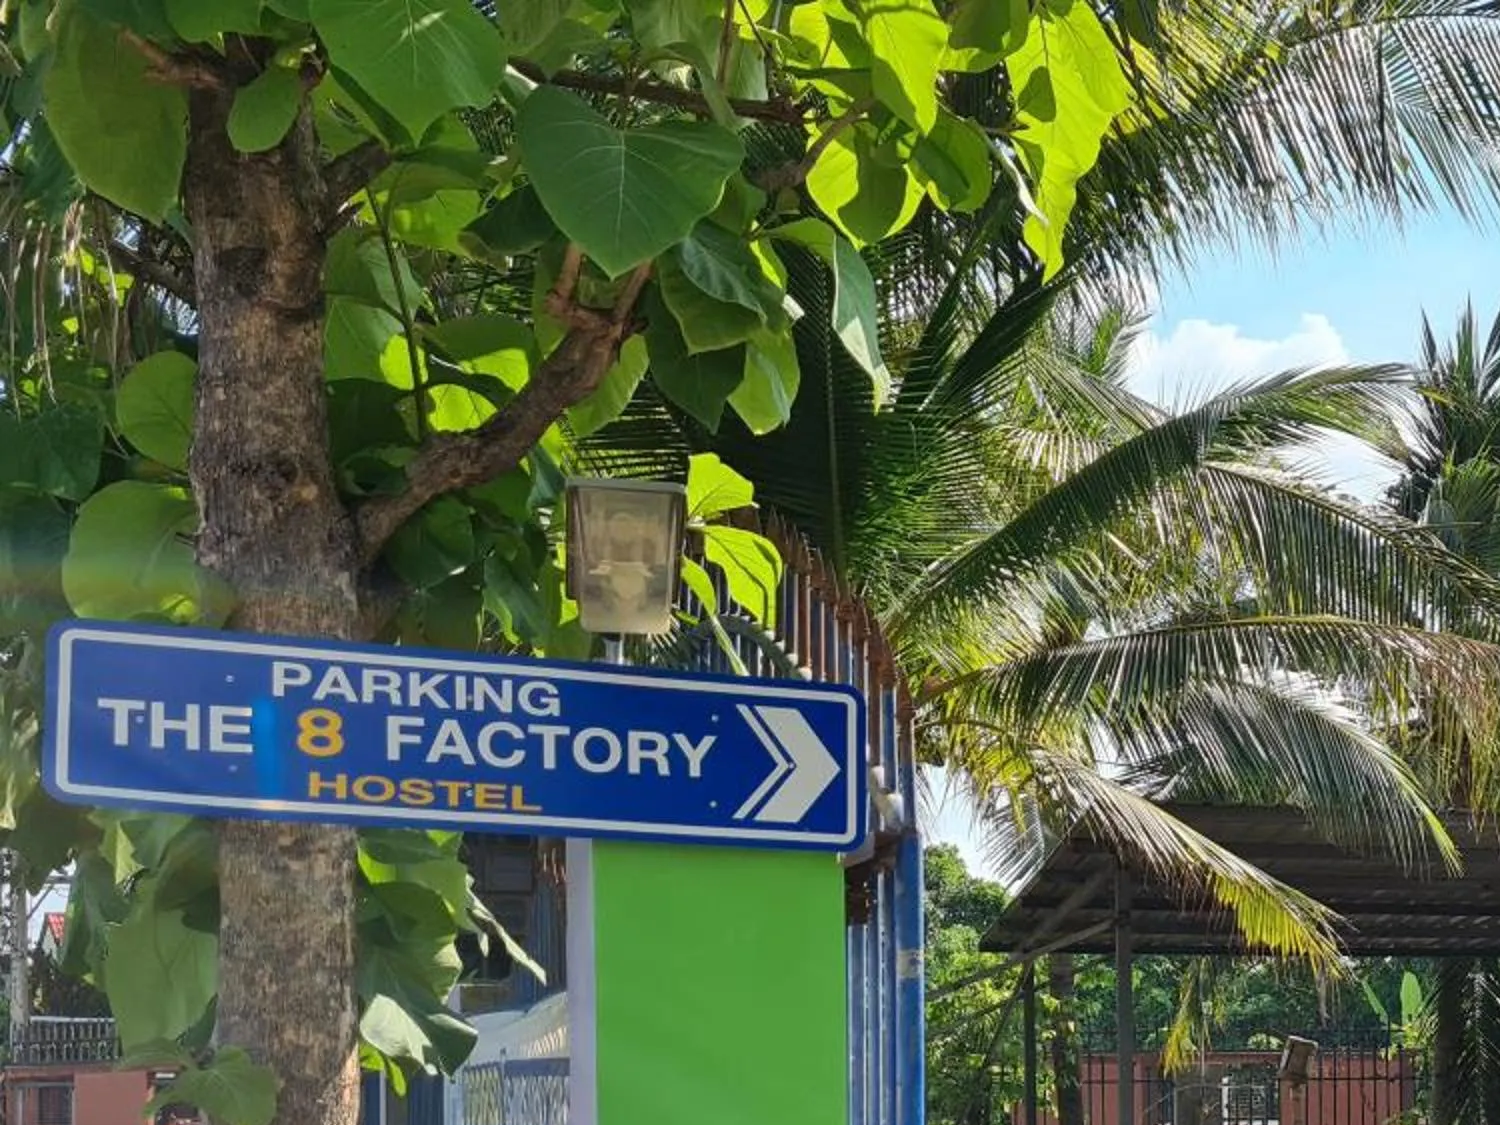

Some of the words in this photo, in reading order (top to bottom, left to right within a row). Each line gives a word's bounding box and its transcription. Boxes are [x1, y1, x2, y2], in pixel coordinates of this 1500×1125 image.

[272, 661, 560, 717] PARKING
[98, 697, 253, 753] THE
[297, 708, 343, 757] 8
[387, 716, 716, 777] FACTORY
[308, 771, 542, 811] HOSTEL
